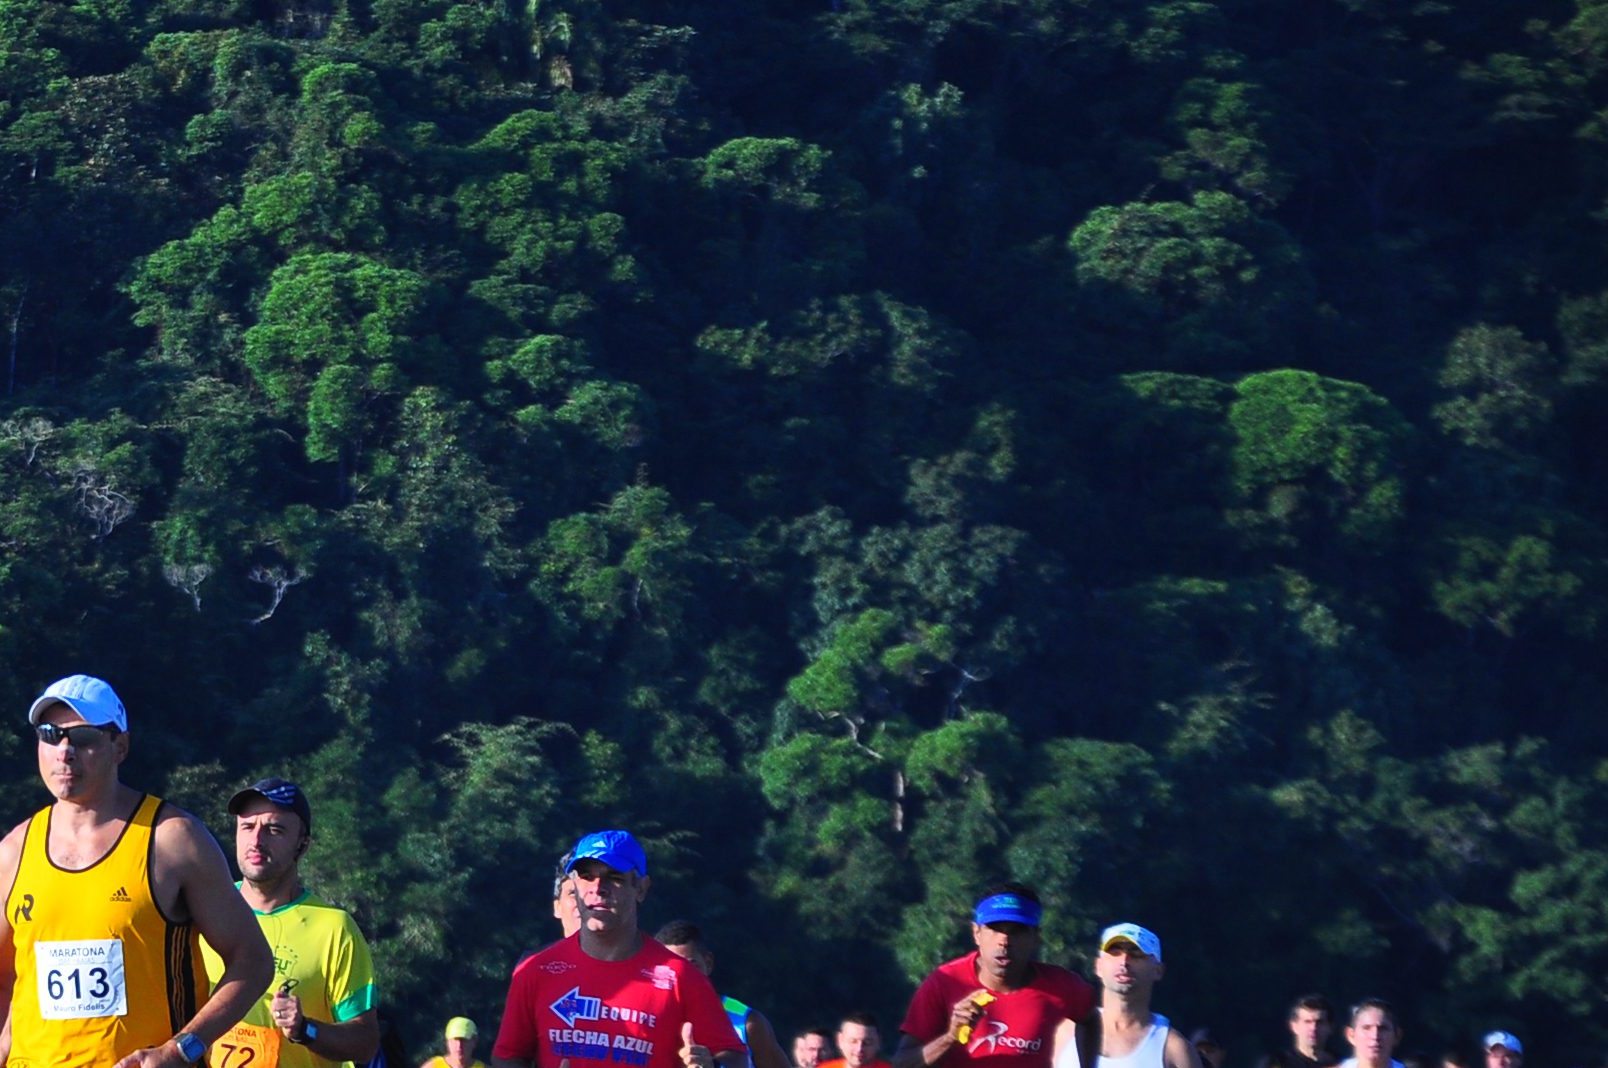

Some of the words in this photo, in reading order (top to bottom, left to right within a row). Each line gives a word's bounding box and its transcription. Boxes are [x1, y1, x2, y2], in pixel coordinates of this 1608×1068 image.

[49, 946, 106, 958] MARATONA
[47, 966, 110, 1001] 613
[600, 1006, 657, 1028] EQUIPE
[549, 1029, 610, 1047] FLECHA
[612, 1034, 654, 1055] AZUL
[969, 1021, 1042, 1054] Record
